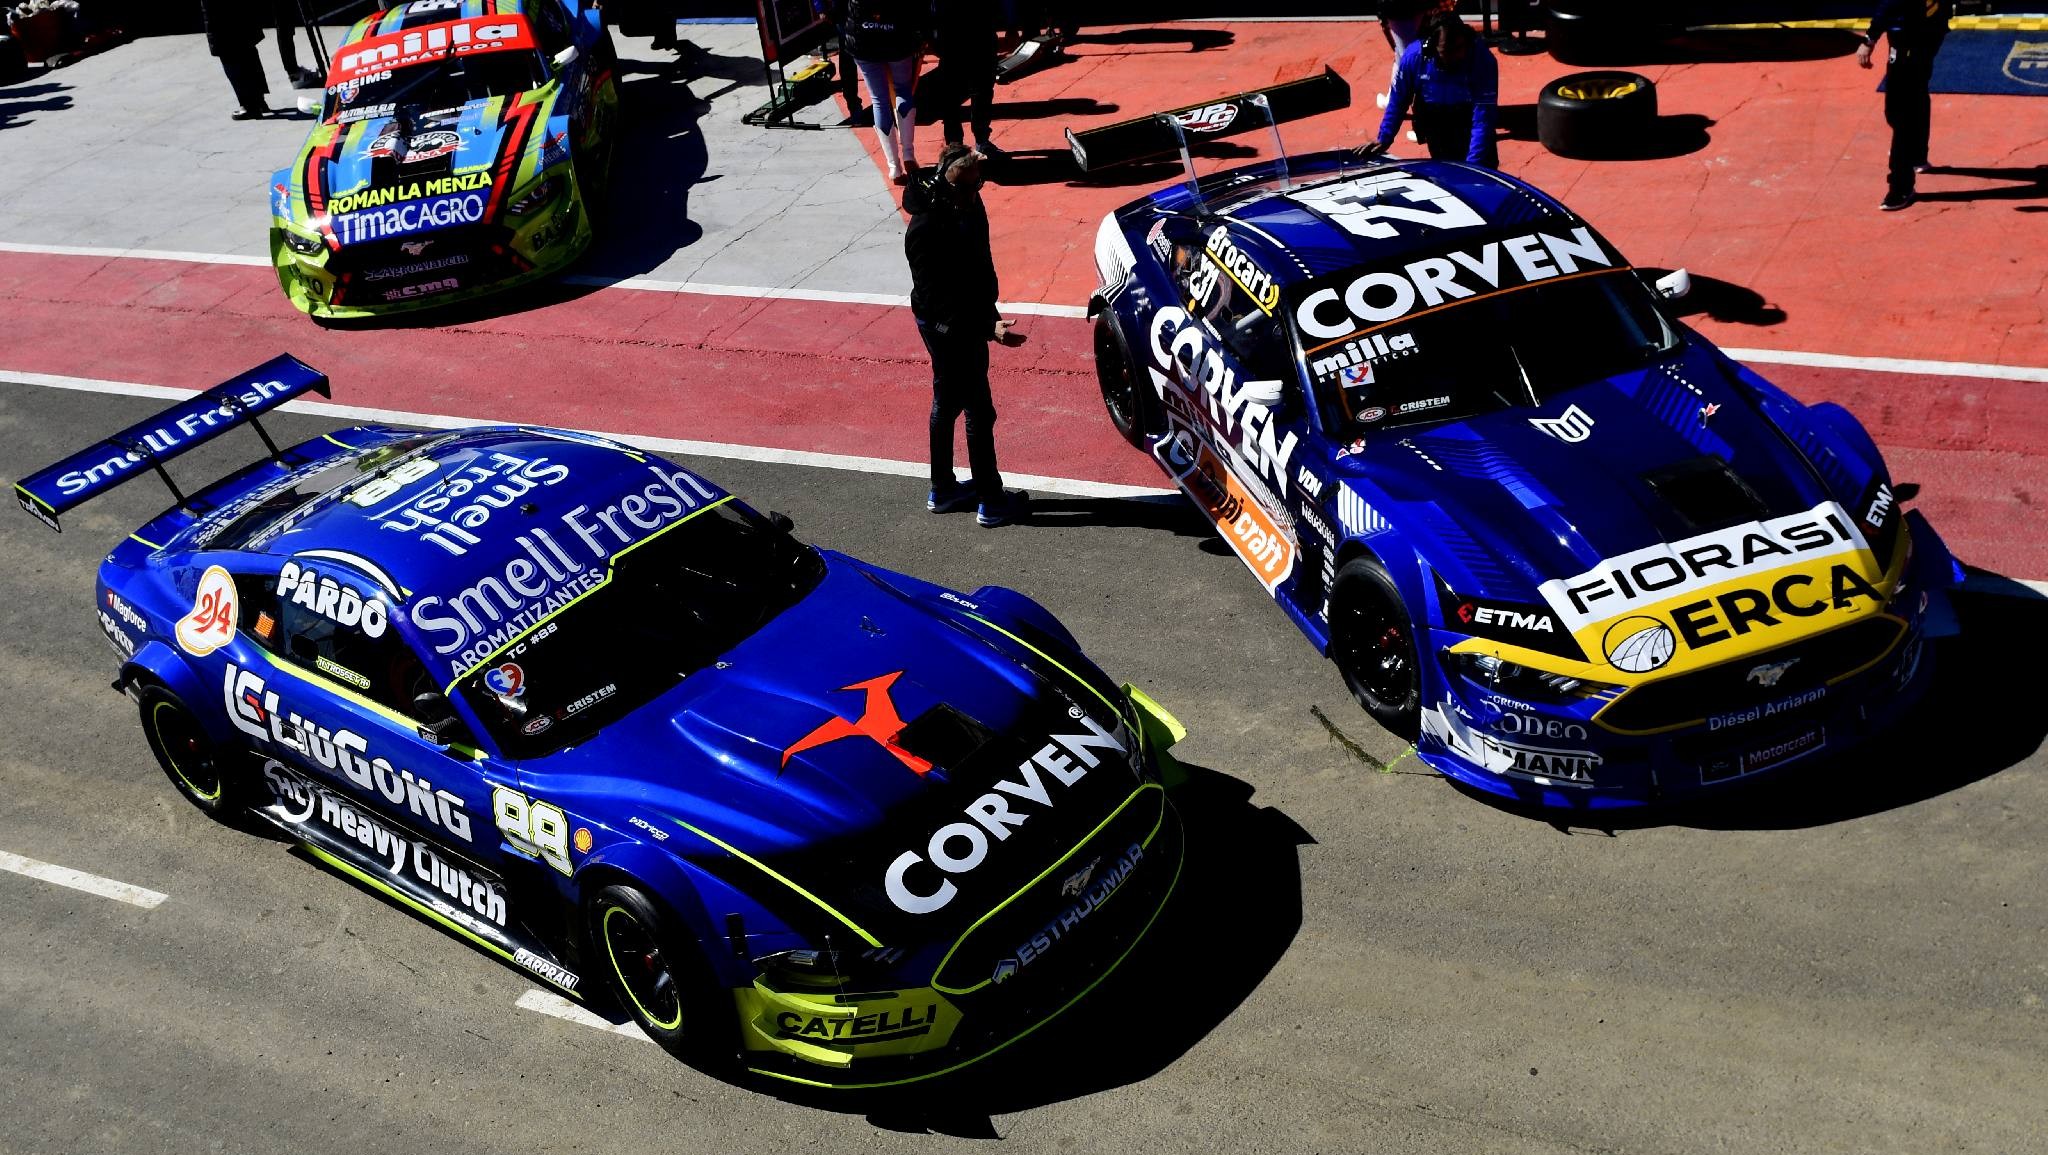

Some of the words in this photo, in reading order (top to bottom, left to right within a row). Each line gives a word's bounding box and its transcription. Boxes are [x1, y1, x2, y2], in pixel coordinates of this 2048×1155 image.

[341, 23, 518, 71] milla
[337, 70, 392, 93] REIMS
[327, 186, 395, 215] ROMAN
[398, 182, 422, 201] LA
[426, 170, 493, 196] MENZA
[1206, 225, 1272, 303] Brocart
[1296, 226, 1612, 339] CORVEN
[1312, 332, 1416, 377] milla
[1150, 306, 1299, 500] CORVEN
[1400, 396, 1450, 412] CRISTEM
[56, 426, 182, 496] Smell
[175, 377, 292, 438] Fresh
[381, 451, 529, 533] Fresh
[1298, 465, 1323, 498] VDN
[419, 456, 570, 556] Smell
[411, 526, 584, 656] Smell
[561, 465, 716, 558] Fresh
[1567, 512, 1853, 615] FIORASI
[113, 595, 147, 633] Magforce
[277, 561, 388, 639] PARDO
[450, 568, 606, 678] AROMATIZANTES
[1474, 606, 1556, 634] ETMA
[1670, 562, 1887, 651] ERCA
[506, 642, 527, 659] TC
[530, 622, 558, 645] #88
[566, 682, 617, 713] CRISTEM
[1709, 706, 1761, 731] Diésel
[1765, 686, 1826, 717] Arriaran
[1749, 730, 1817, 766] Motorcraft
[321, 795, 407, 875] Heavy
[414, 842, 507, 927] Clutch
[515, 949, 578, 990] BARPRAN
[776, 1002, 937, 1039] CATELLI
